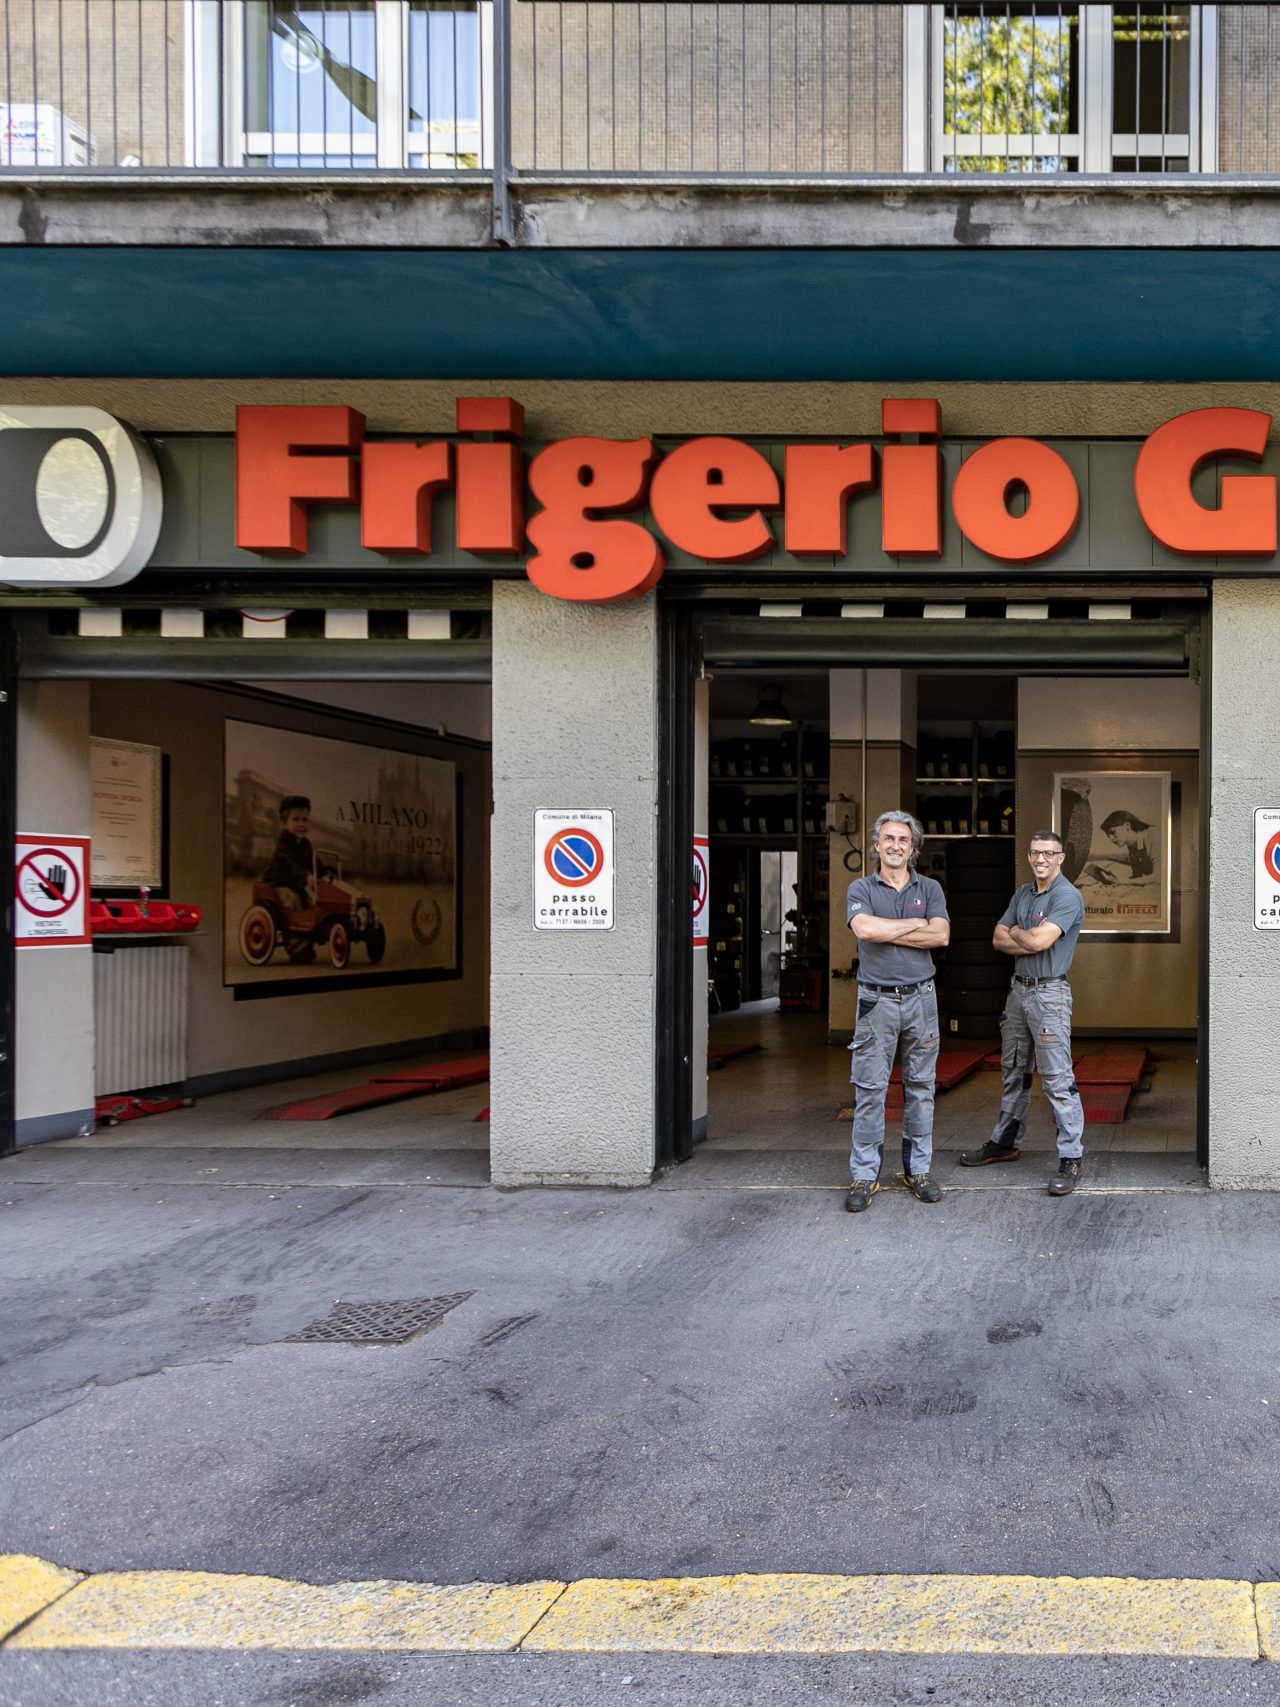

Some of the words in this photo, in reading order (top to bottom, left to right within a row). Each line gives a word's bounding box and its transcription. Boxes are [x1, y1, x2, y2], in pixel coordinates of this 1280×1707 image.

[235, 397, 1080, 602] Frigerio
[335, 806, 345, 822] A
[350, 800, 428, 830] MILANO
[411, 836, 442, 856] 1922
[552, 894, 596, 904] passo
[540, 906, 608, 917] carrabile
[1116, 903, 1158, 915] PIRELLI
